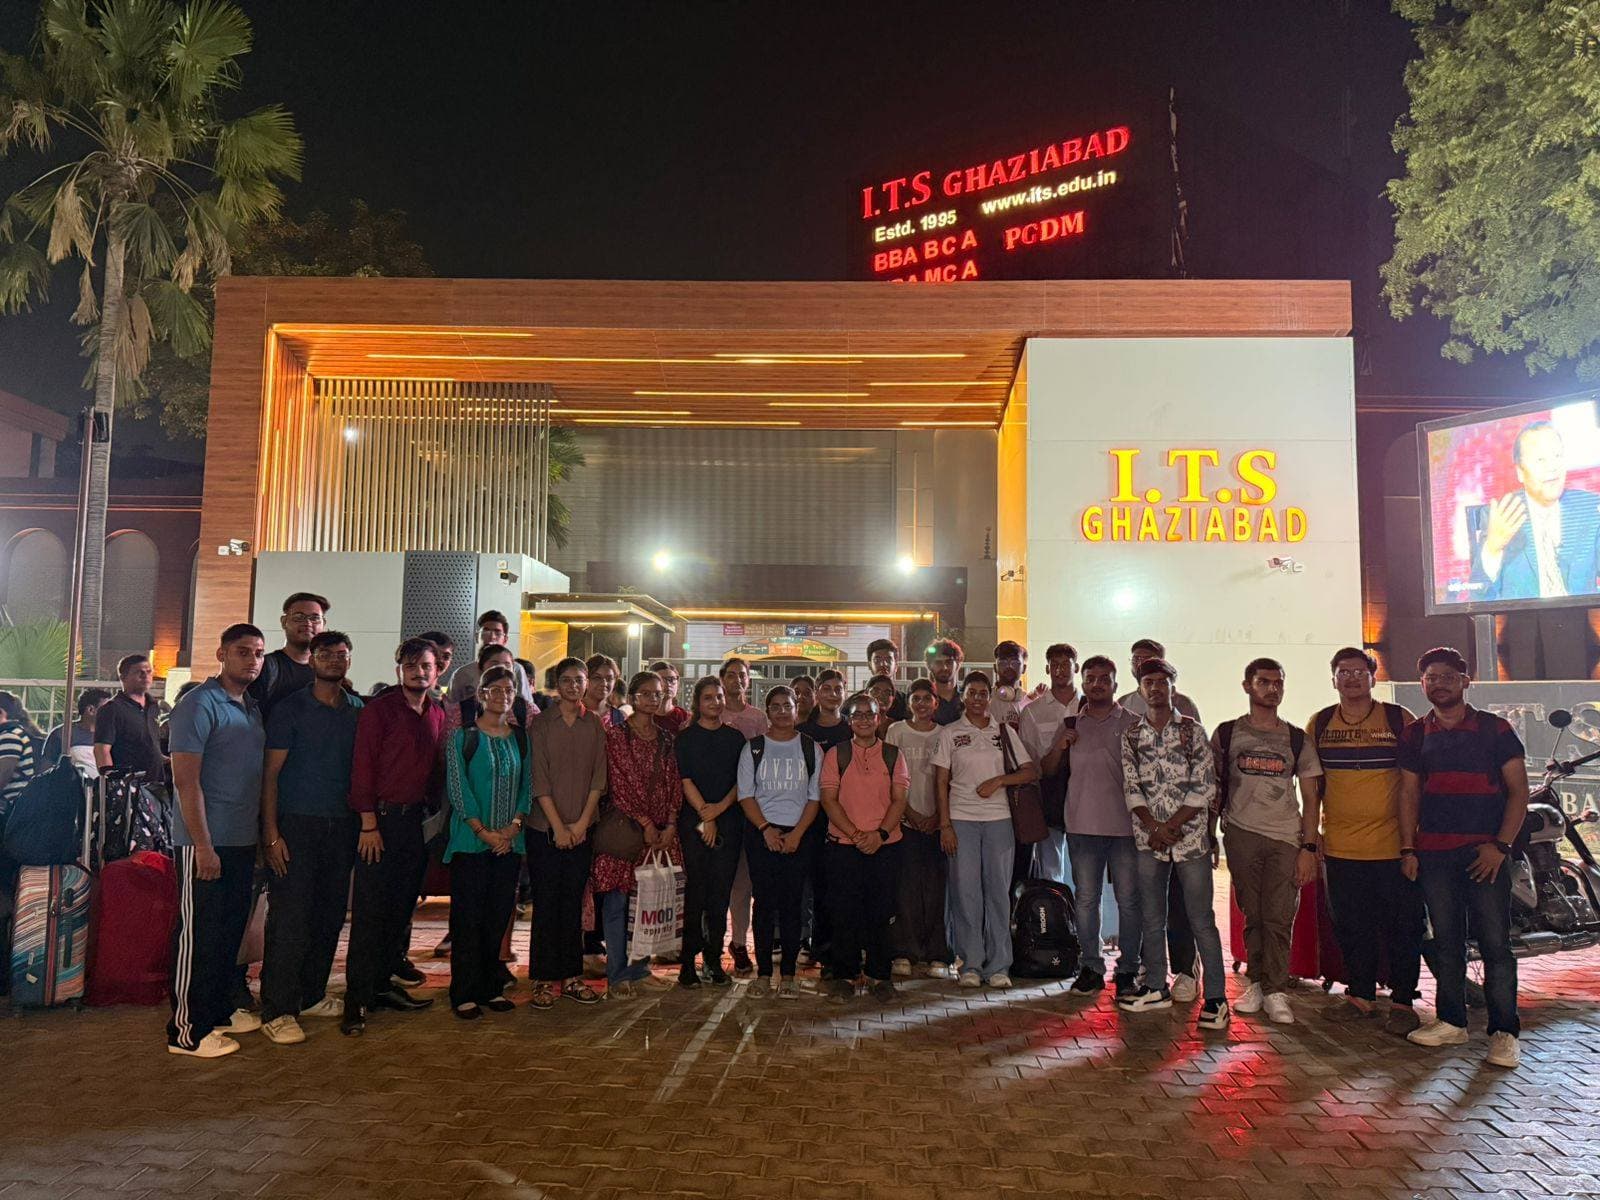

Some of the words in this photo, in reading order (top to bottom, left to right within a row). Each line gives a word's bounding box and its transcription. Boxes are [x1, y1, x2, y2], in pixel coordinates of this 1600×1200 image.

[862, 171, 932, 219] I.T.S
[943, 126, 1130, 197] GHAZIABAD
[981, 169, 1117, 214] www.its.edu.in
[875, 220, 916, 242] Estd.
[920, 210, 957, 231] 1995
[874, 246, 918, 272] BBA
[1109, 449, 1277, 505] I.T.S
[1082, 506, 1307, 542] GHAZIABAD
[760, 758, 806, 780] OVER
